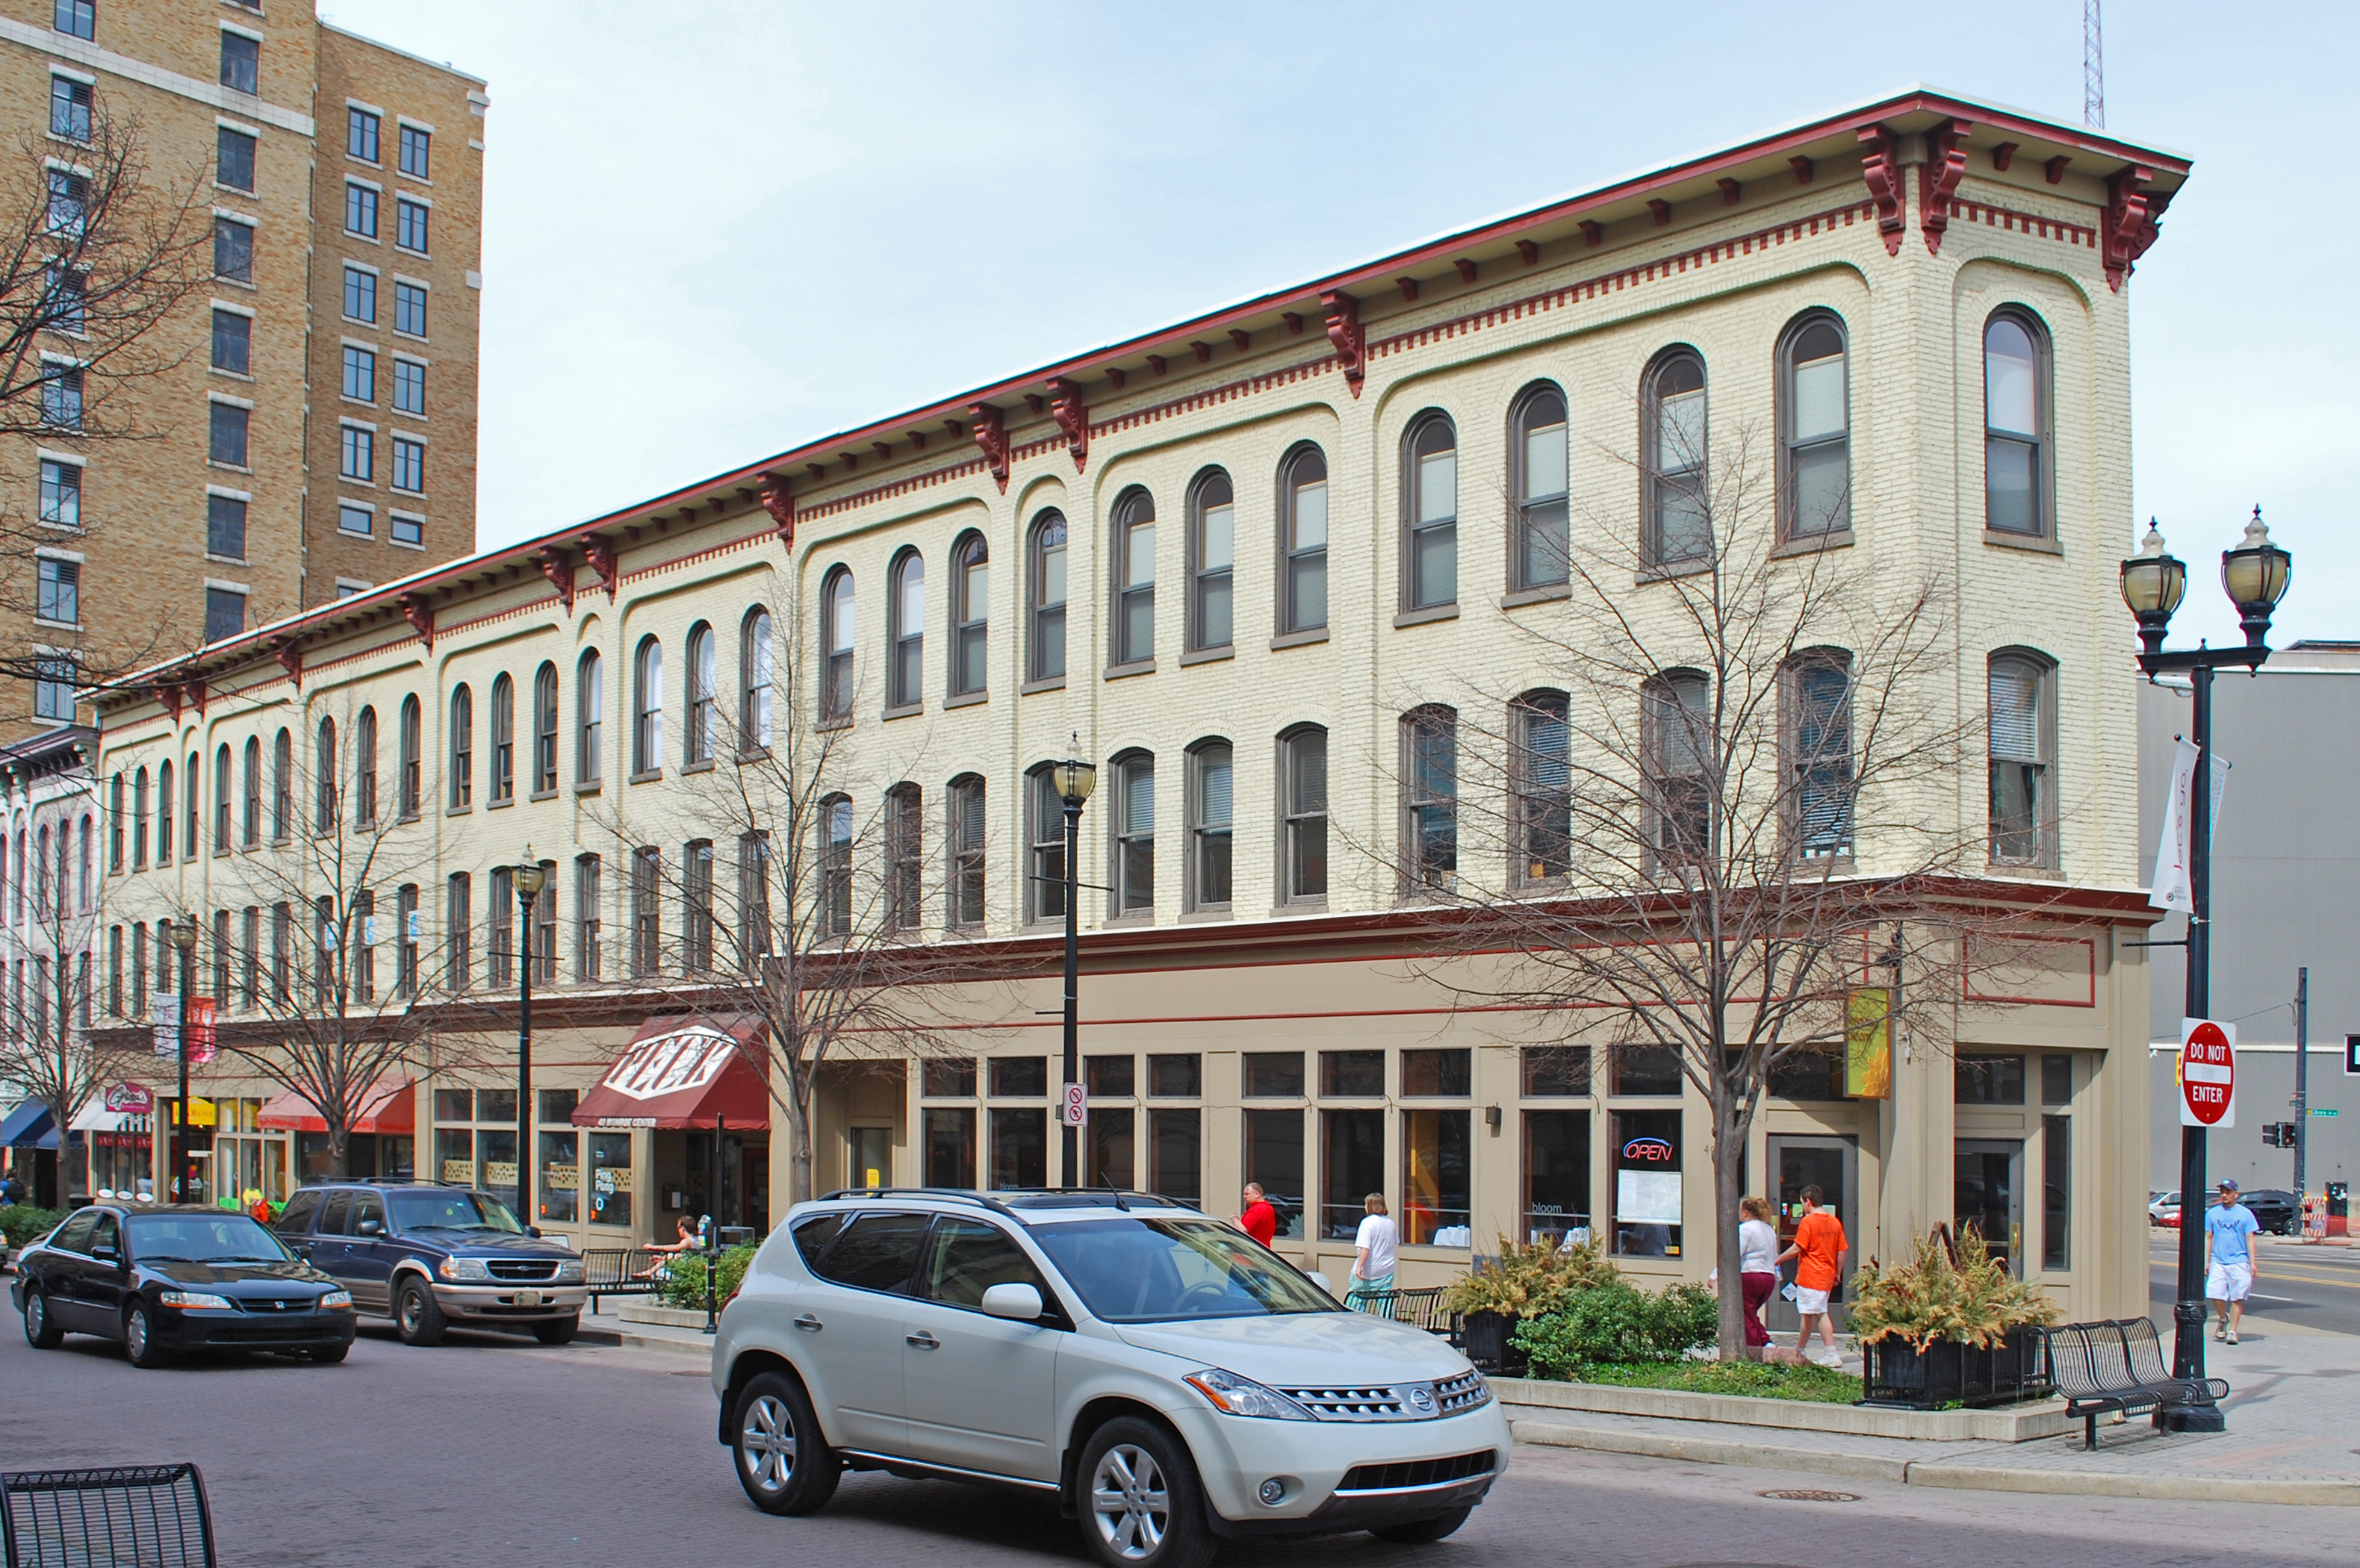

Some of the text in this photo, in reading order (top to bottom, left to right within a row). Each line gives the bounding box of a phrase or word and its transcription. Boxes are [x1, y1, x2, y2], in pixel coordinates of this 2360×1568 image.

[2190, 1042, 2226, 1062] DO NOT
[2192, 1086, 2223, 1104] ENTER
[1626, 1142, 1674, 1162] OPEN
[595, 1180, 615, 1195] Pong
[1532, 1201, 1562, 1213] bloom
